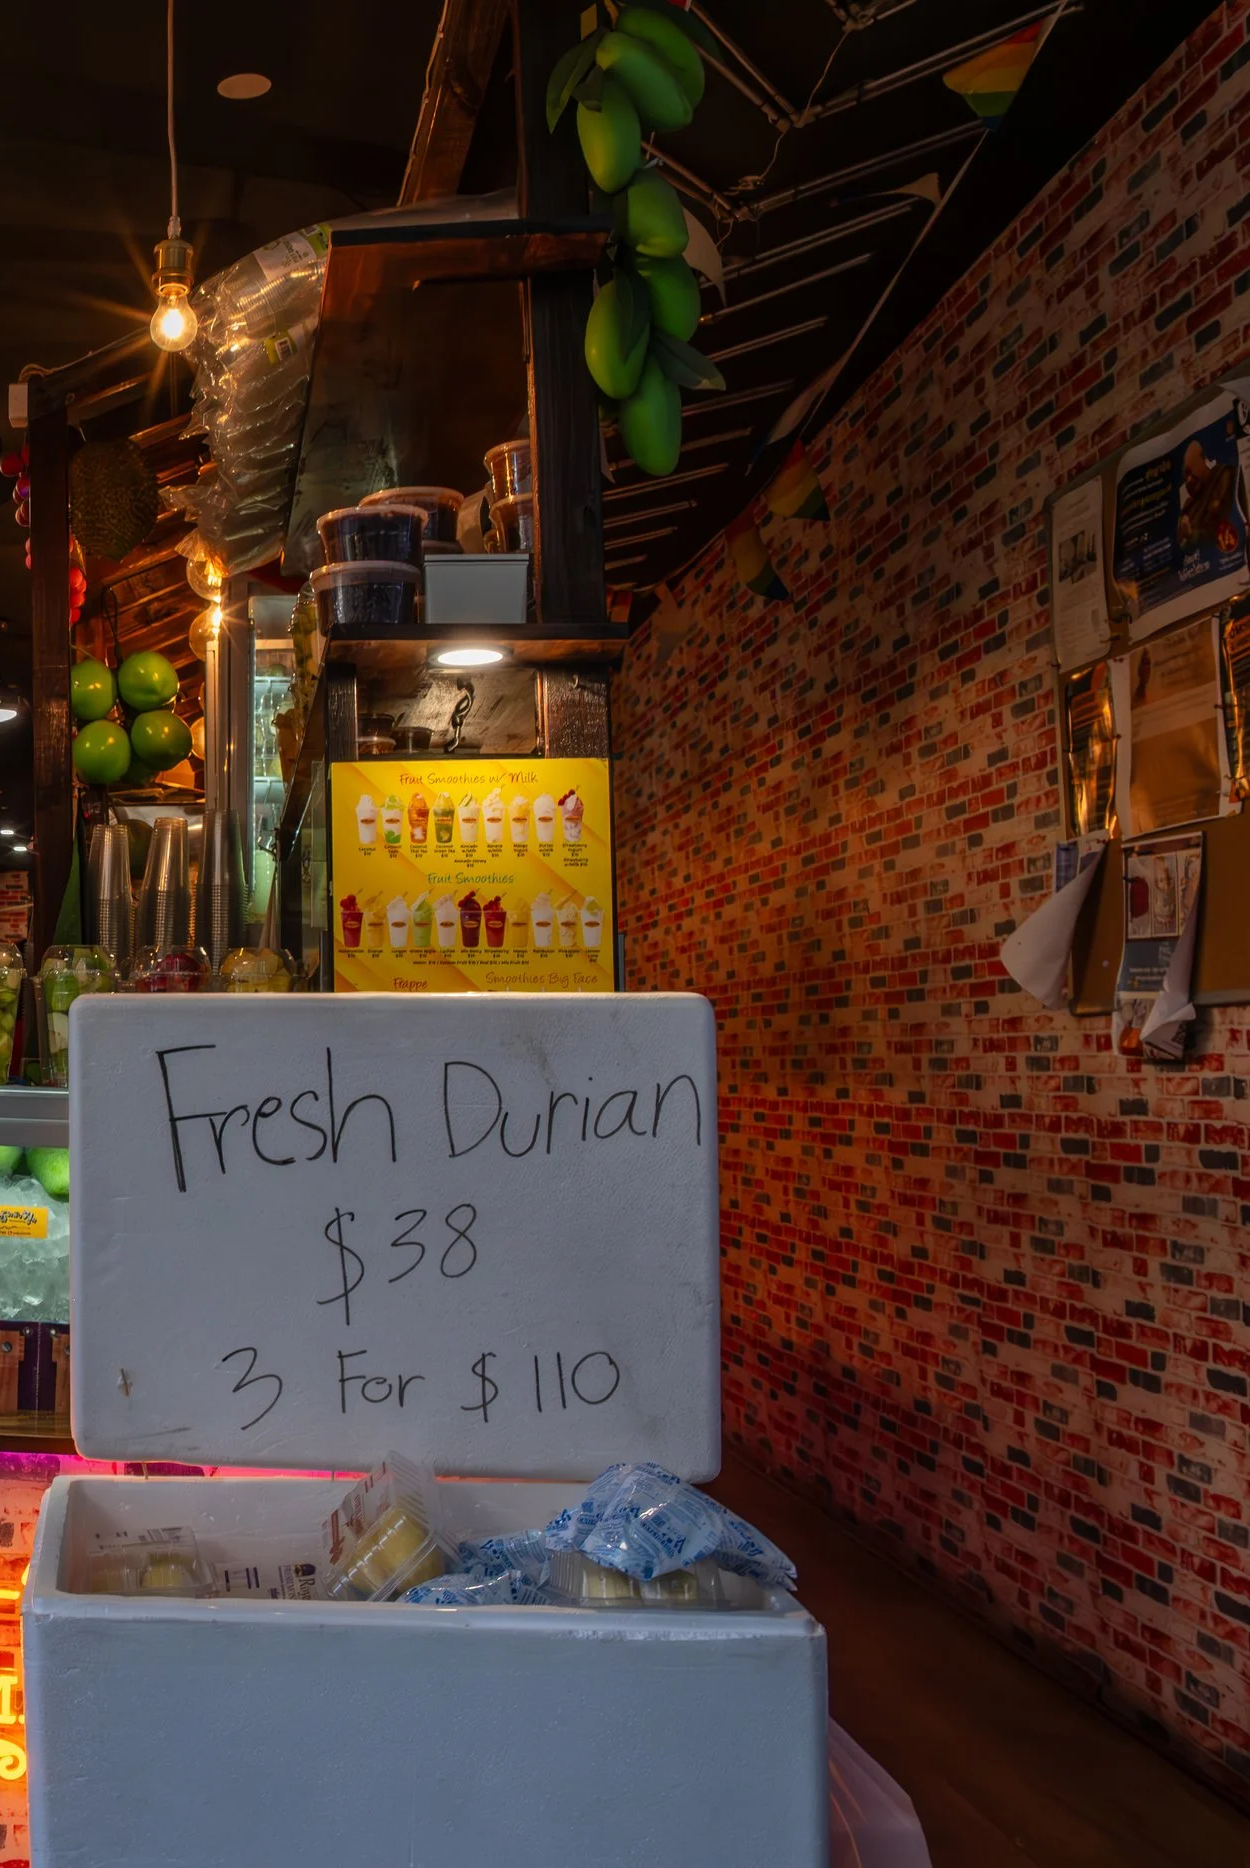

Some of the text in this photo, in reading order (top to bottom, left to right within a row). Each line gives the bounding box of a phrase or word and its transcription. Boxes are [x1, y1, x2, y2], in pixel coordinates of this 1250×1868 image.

[399, 773, 424, 786] Fruit
[427, 772, 486, 785] Smoothies
[508, 771, 539, 784] Milk
[427, 872, 515, 885] Fruit Smoothies
[485, 971, 599, 988] Smoothies Big Face
[154, 1043, 704, 1194] Fresh Durian
[315, 1202, 479, 1326] $38
[220, 1346, 284, 1432] 3
[336, 1348, 425, 1414] For
